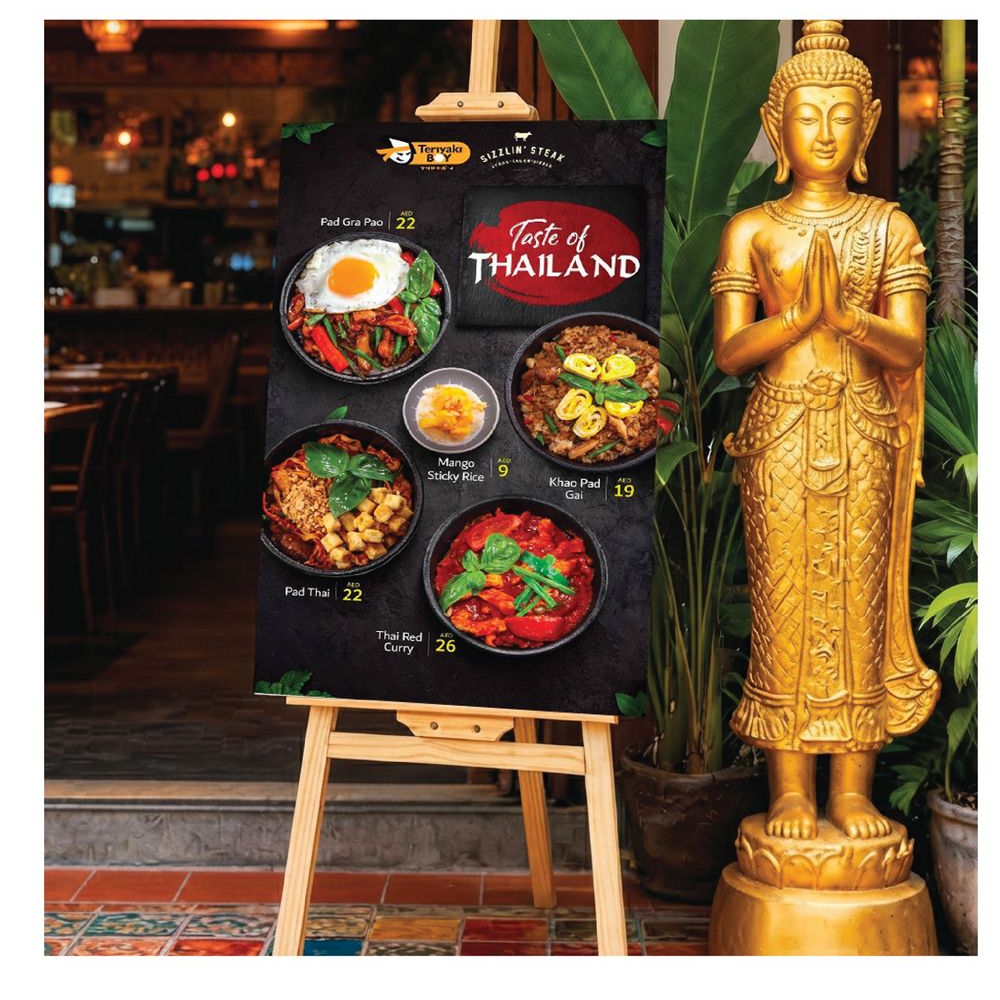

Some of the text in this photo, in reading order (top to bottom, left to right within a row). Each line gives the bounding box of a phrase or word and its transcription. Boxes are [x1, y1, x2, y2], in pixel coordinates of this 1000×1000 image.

[418, 144, 463, 154] Teriyaki
[480, 145, 565, 163] SIZZLIN' STEAK
[320, 217, 384, 227] Pad Gra Pao
[395, 217, 416, 230] 22
[509, 218, 591, 253] Taste of
[467, 252, 641, 285] THAILAND
[438, 457, 475, 470] Mango
[427, 470, 485, 484] Sticky Rice
[498, 464, 509, 477] 9
[549, 477, 601, 489] Khao Pad
[565, 489, 584, 500] Gai
[614, 484, 635, 498] 19
[285, 587, 330, 598] Pad Thai
[342, 588, 363, 601] 22
[376, 630, 423, 642] Thai Red
[384, 642, 414, 655] Curry
[435, 638, 456, 653] 26
